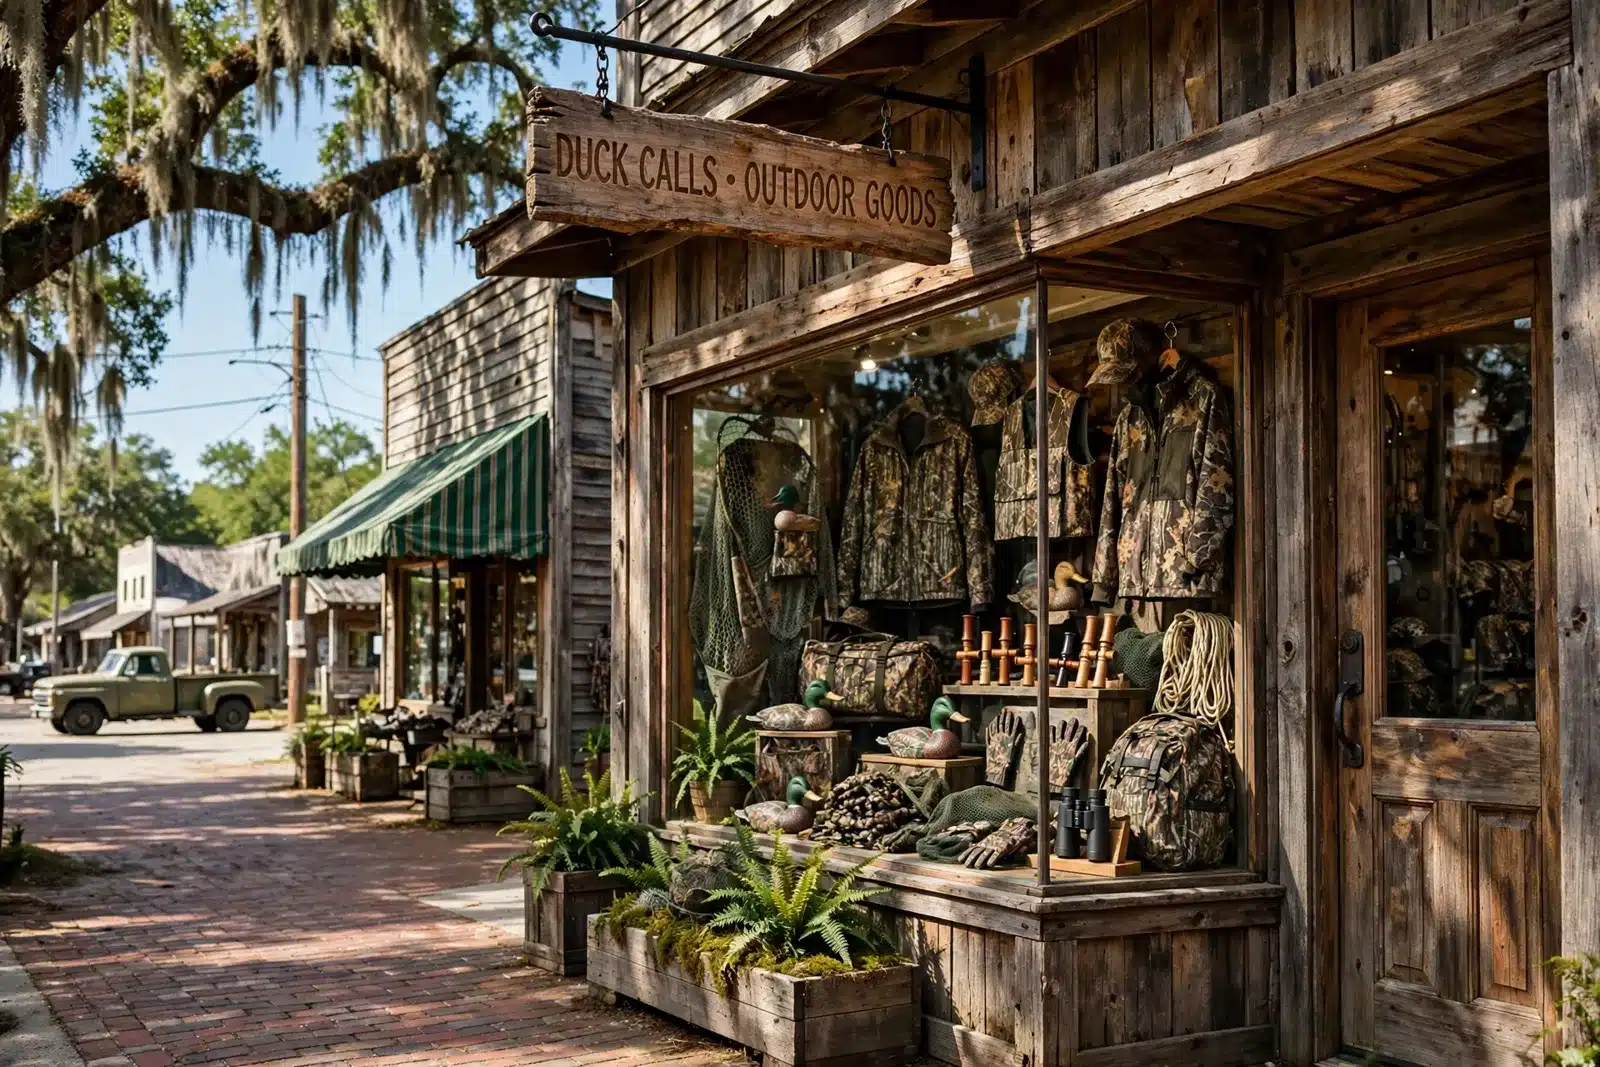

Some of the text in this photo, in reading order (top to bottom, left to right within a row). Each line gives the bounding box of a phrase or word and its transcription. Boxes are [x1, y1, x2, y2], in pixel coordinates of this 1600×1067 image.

[556, 132, 629, 187] DUCK
[639, 145, 718, 198] CALLS
[744, 161, 856, 218] OUTDOOR
[865, 180, 937, 228] GOODS
